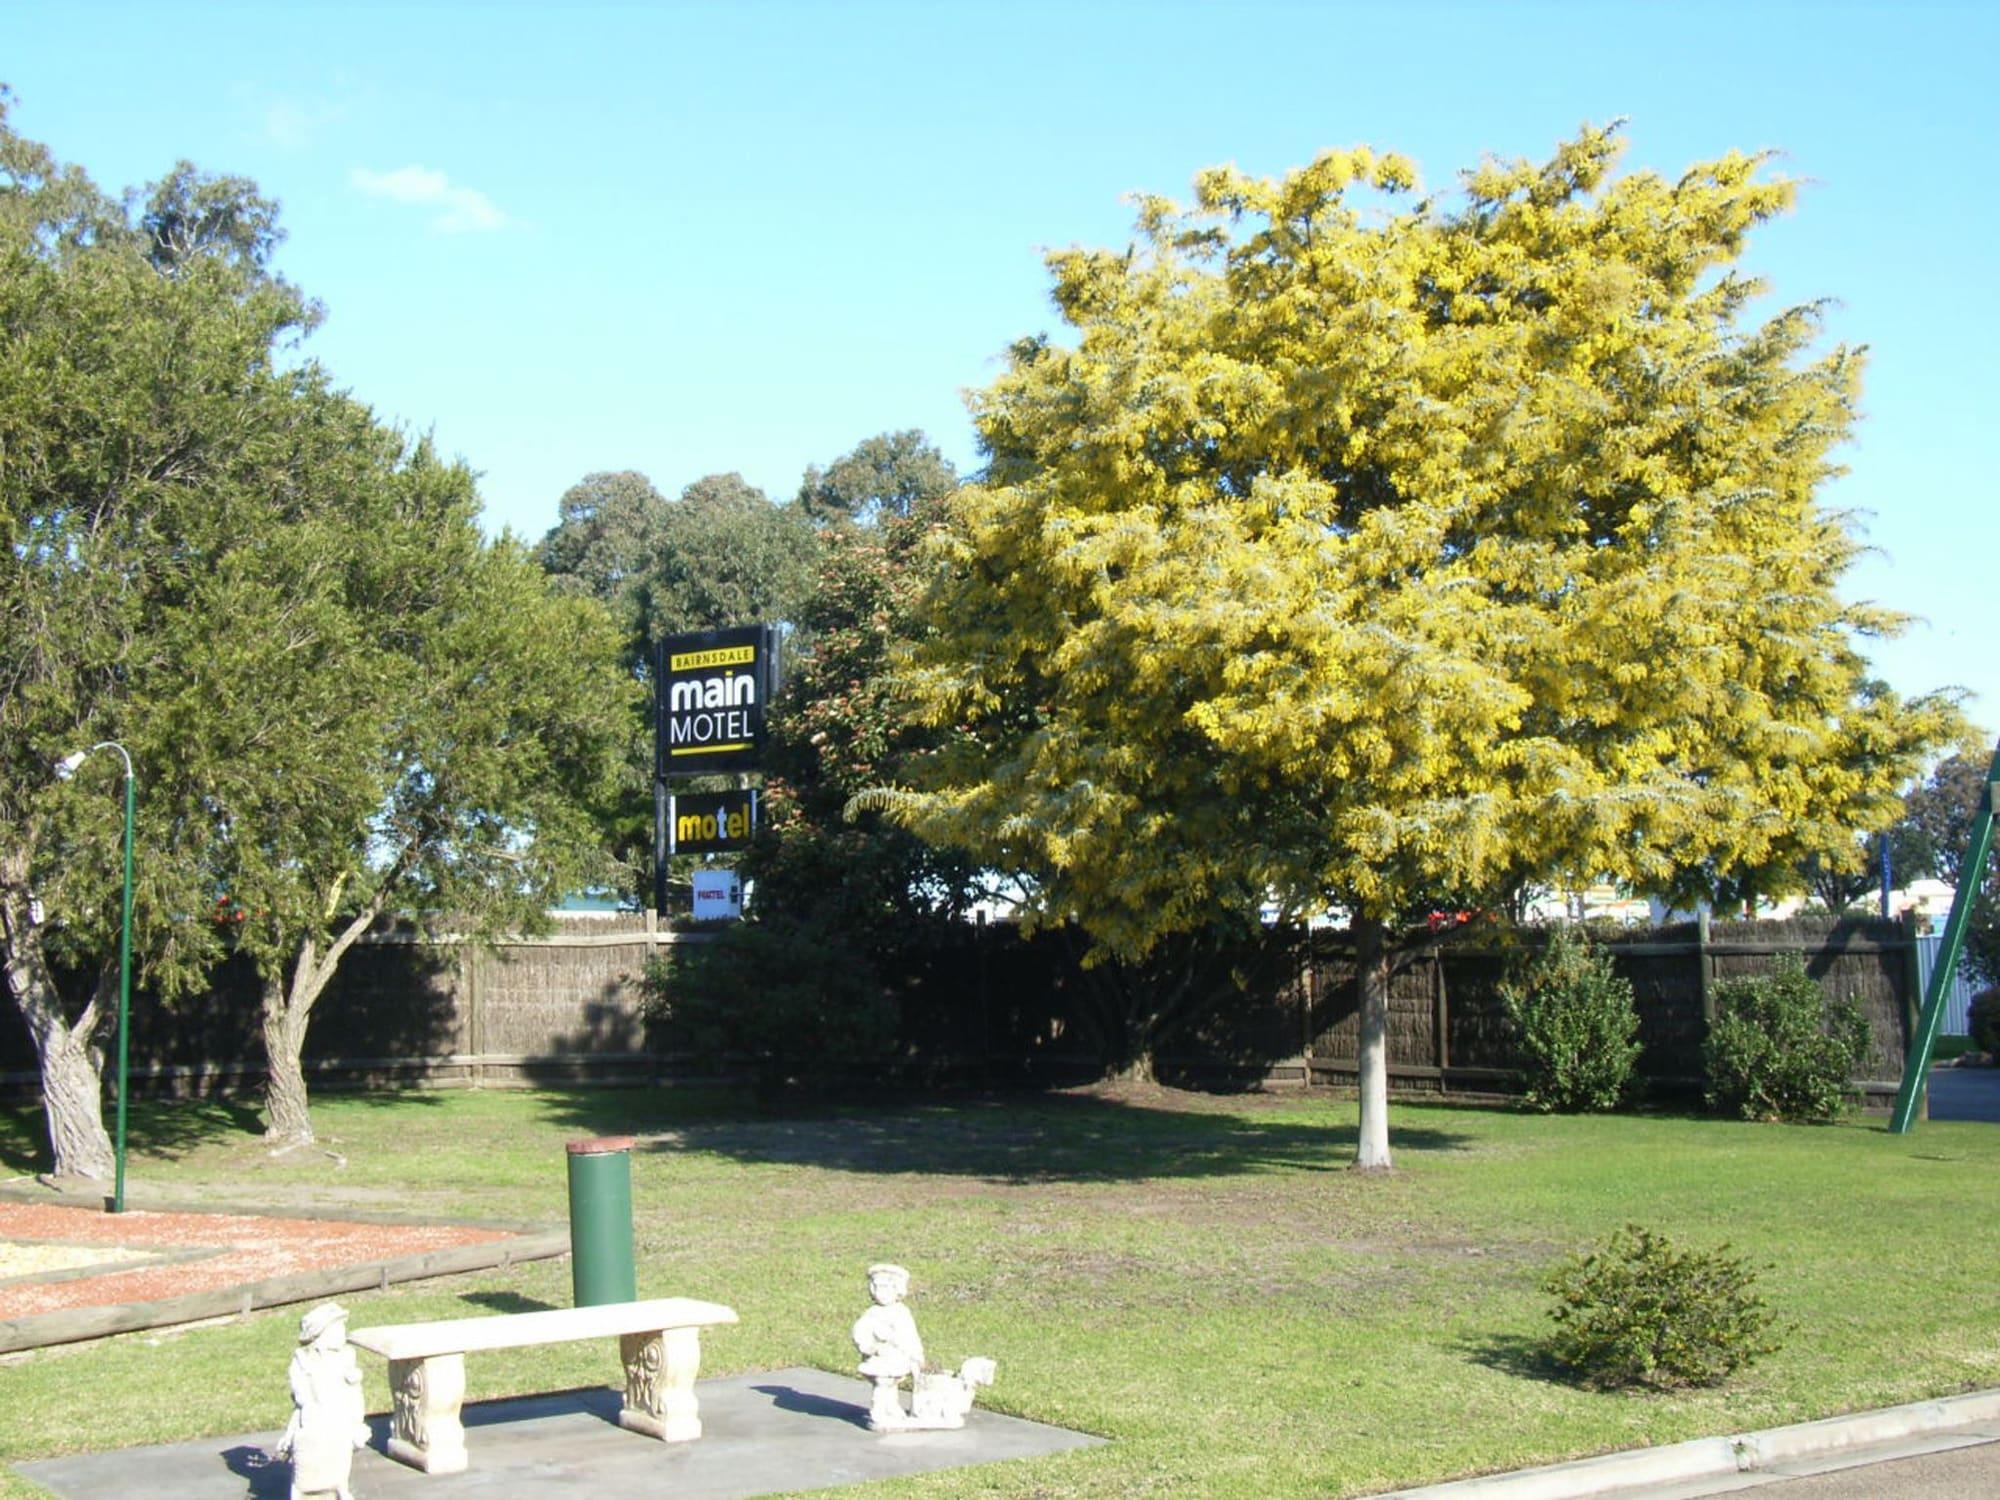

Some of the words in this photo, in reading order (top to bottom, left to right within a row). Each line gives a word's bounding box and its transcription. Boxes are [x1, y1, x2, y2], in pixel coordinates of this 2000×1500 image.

[676, 649, 749, 668] BAIRNSDALE
[671, 670, 755, 712] main
[670, 711, 754, 744] MOTEL
[678, 803, 749, 841] motel
